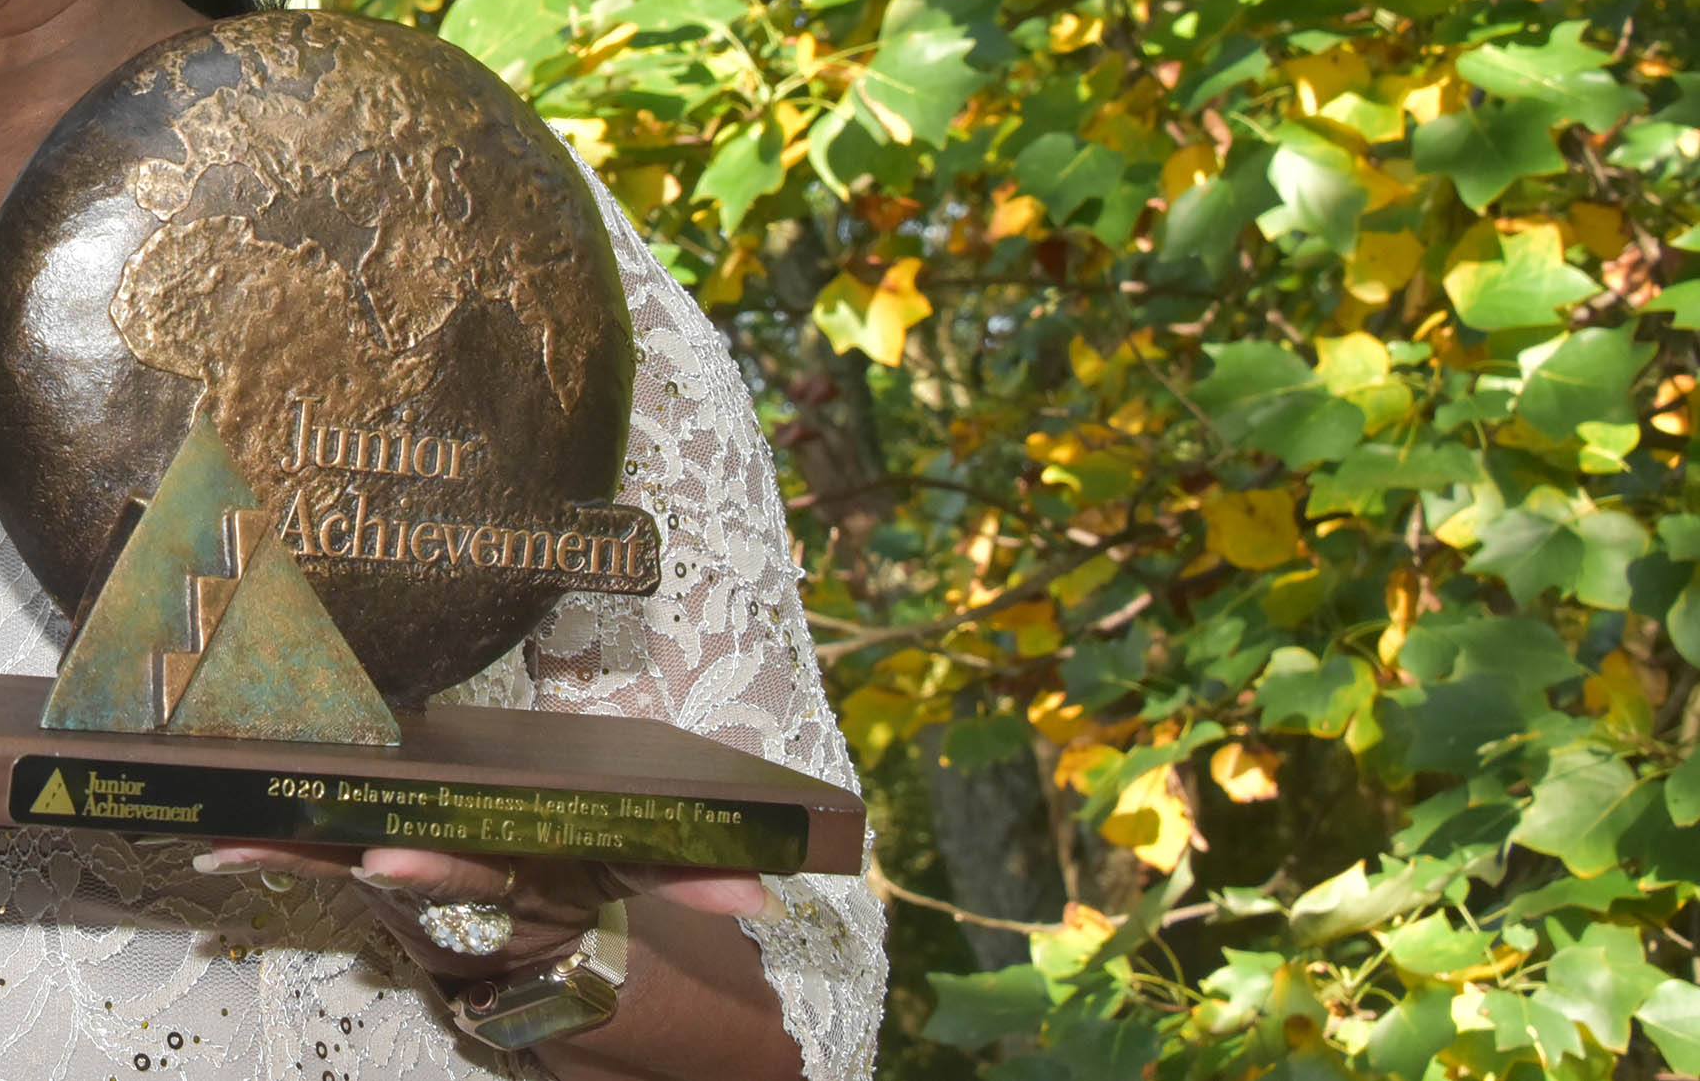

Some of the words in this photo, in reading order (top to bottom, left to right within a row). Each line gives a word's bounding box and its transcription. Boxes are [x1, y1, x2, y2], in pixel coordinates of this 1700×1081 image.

[280, 396, 474, 480] Junior
[280, 488, 645, 578] Achievement
[84, 770, 146, 796] Junior
[267, 776, 325, 800] 2020
[337, 780, 427, 807] Delaware
[438, 787, 525, 812] Business
[533, 792, 609, 817] Leaders
[620, 797, 656, 820] Hall
[664, 801, 685, 821] of
[694, 802, 742, 825] Fame
[386, 812, 468, 840] Devona
[480, 820, 523, 843] E.G.
[536, 822, 625, 849] Williams
